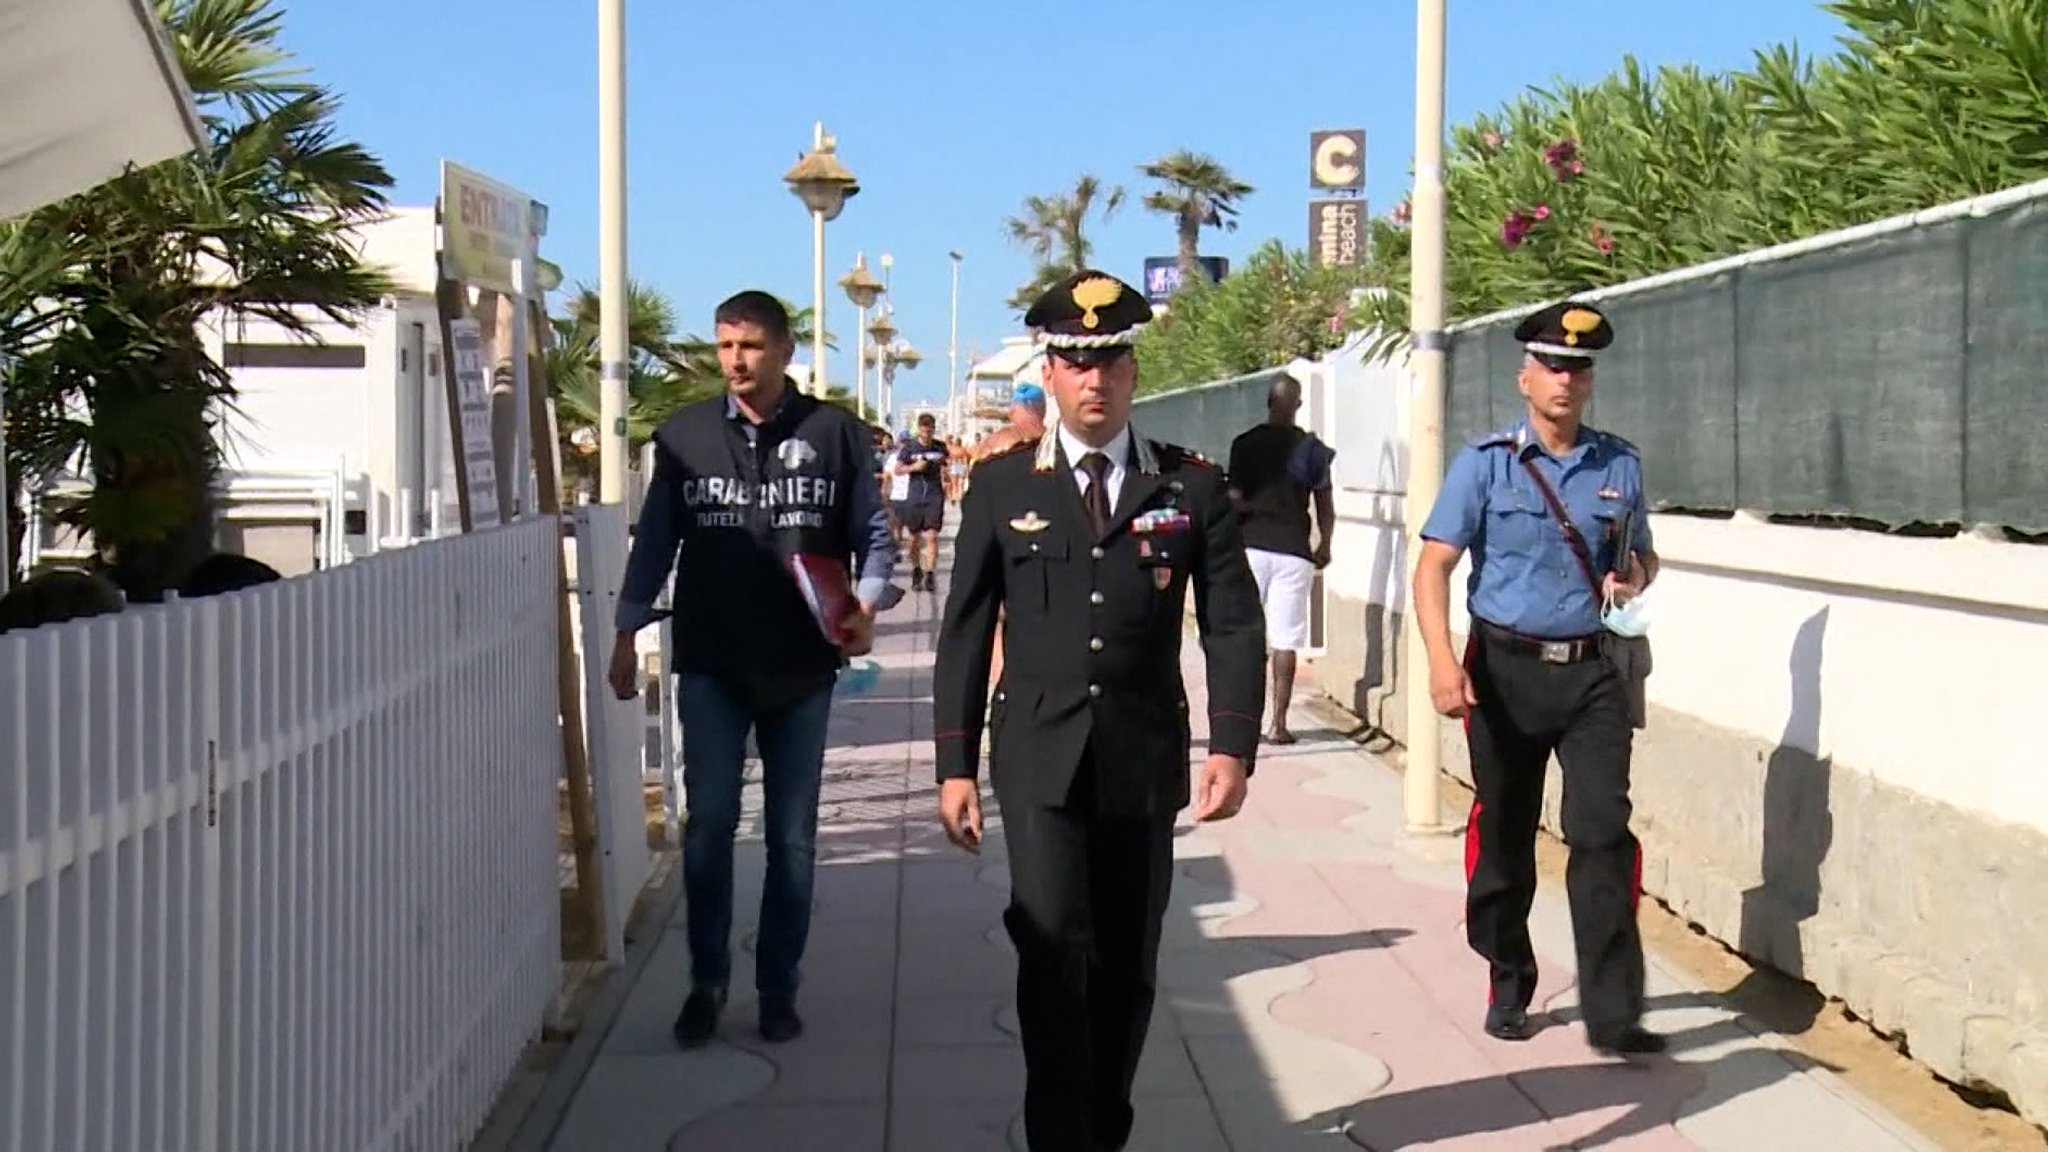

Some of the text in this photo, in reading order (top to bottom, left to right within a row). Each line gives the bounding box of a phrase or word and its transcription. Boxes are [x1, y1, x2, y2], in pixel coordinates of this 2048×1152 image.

[1315, 134, 1360, 186] C
[682, 476, 836, 508] CARABINIERI
[770, 511, 823, 529] LAVORO
